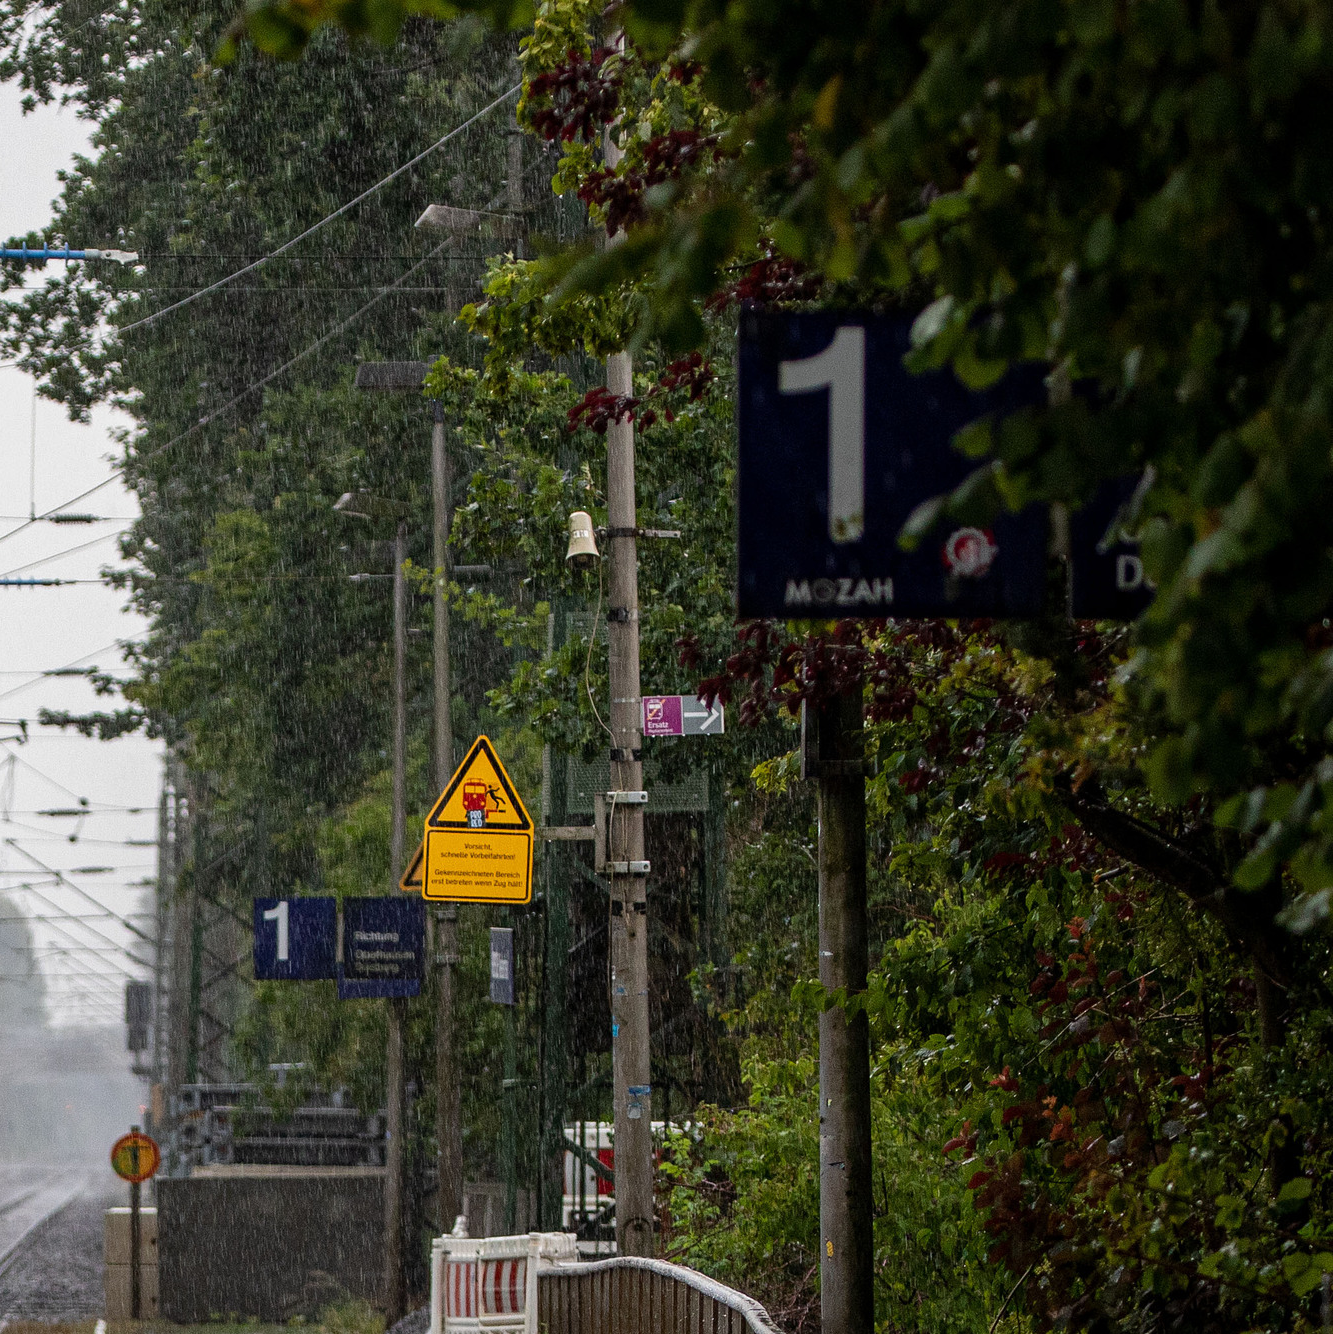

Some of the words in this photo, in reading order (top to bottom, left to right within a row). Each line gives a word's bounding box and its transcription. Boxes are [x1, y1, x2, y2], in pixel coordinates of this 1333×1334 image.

[778, 326, 865, 545] 1
[464, 843, 493, 851] Vorsicht,
[470, 852, 516, 860] Vorbeifahrten!
[434, 868, 494, 877] Gekennzeichneten
[495, 871, 521, 879] Bereich
[445, 878, 473, 886] betreten
[493, 880, 506, 888] Zug
[263, 901, 289, 961] 1
[354, 931, 400, 943] Richtung
